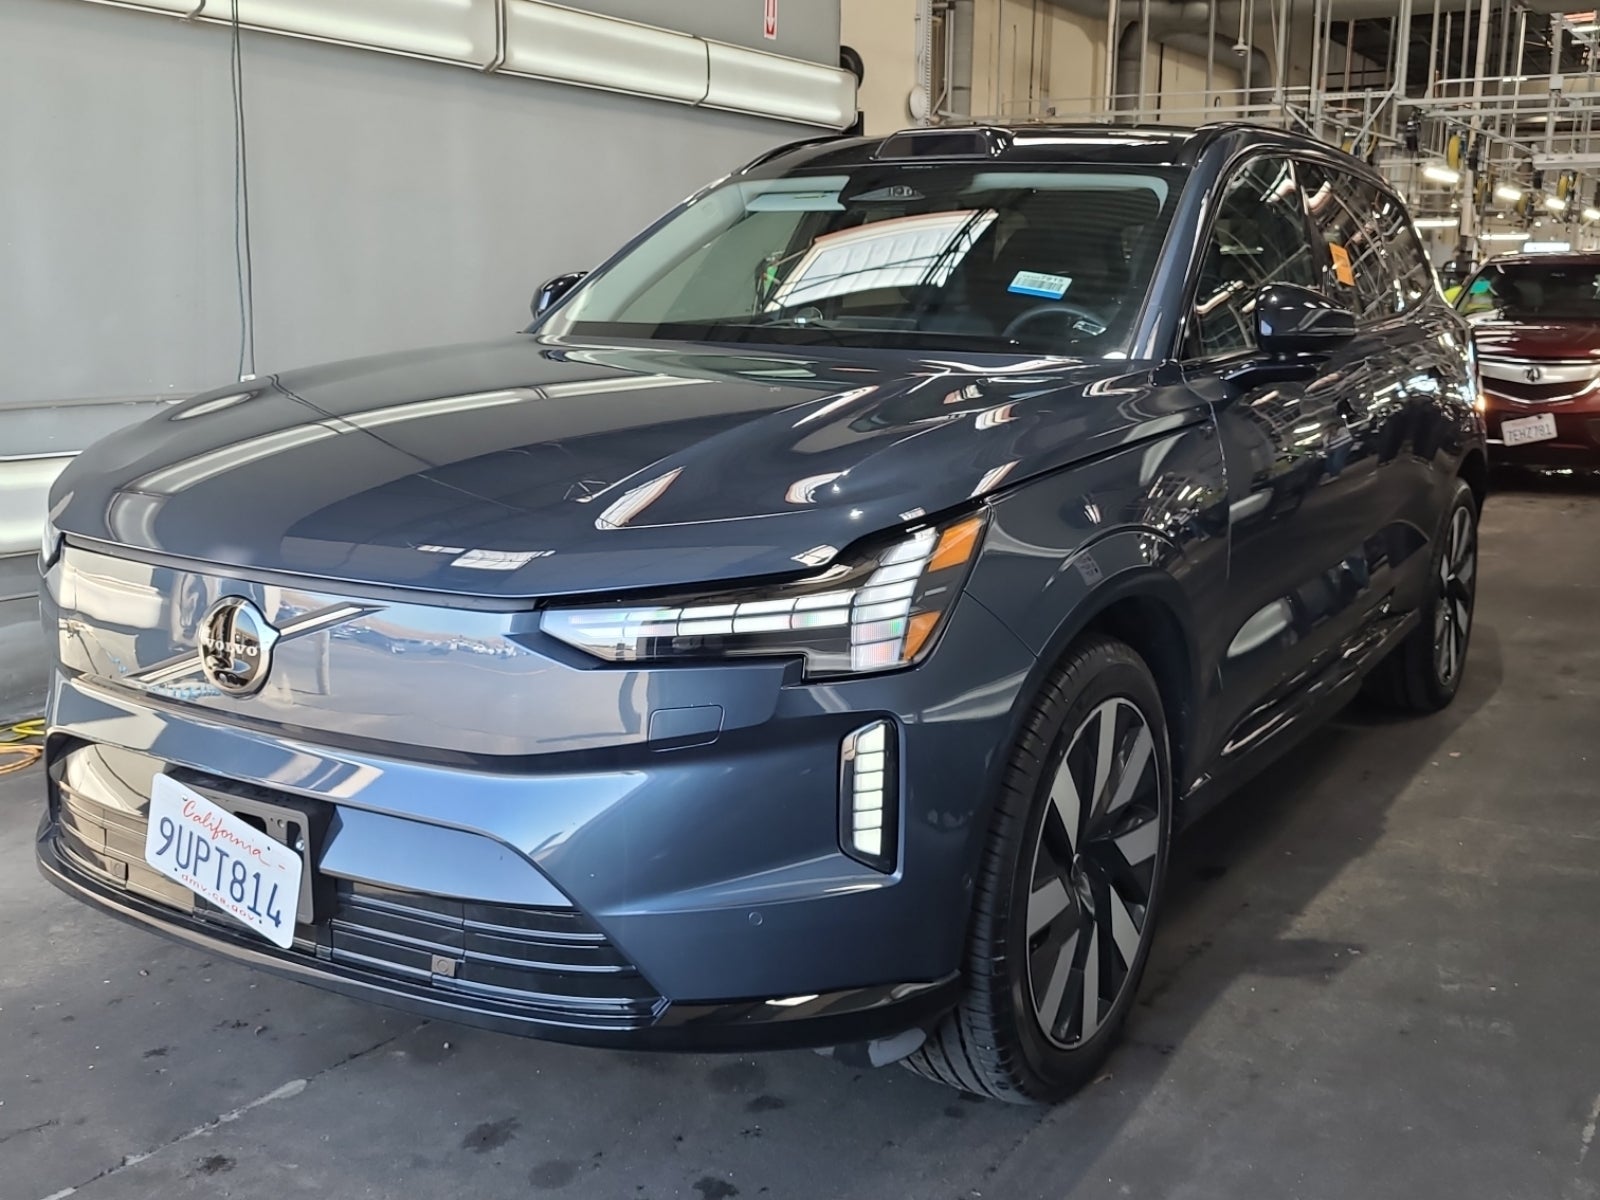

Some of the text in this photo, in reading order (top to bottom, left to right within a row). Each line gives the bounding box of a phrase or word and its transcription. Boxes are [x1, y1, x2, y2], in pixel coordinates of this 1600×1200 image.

[204, 638, 258, 657] VOLVO
[183, 799, 271, 867] California
[155, 816, 282, 928] 9UPT814
[181, 873, 255, 921] dmv.ca.gov
